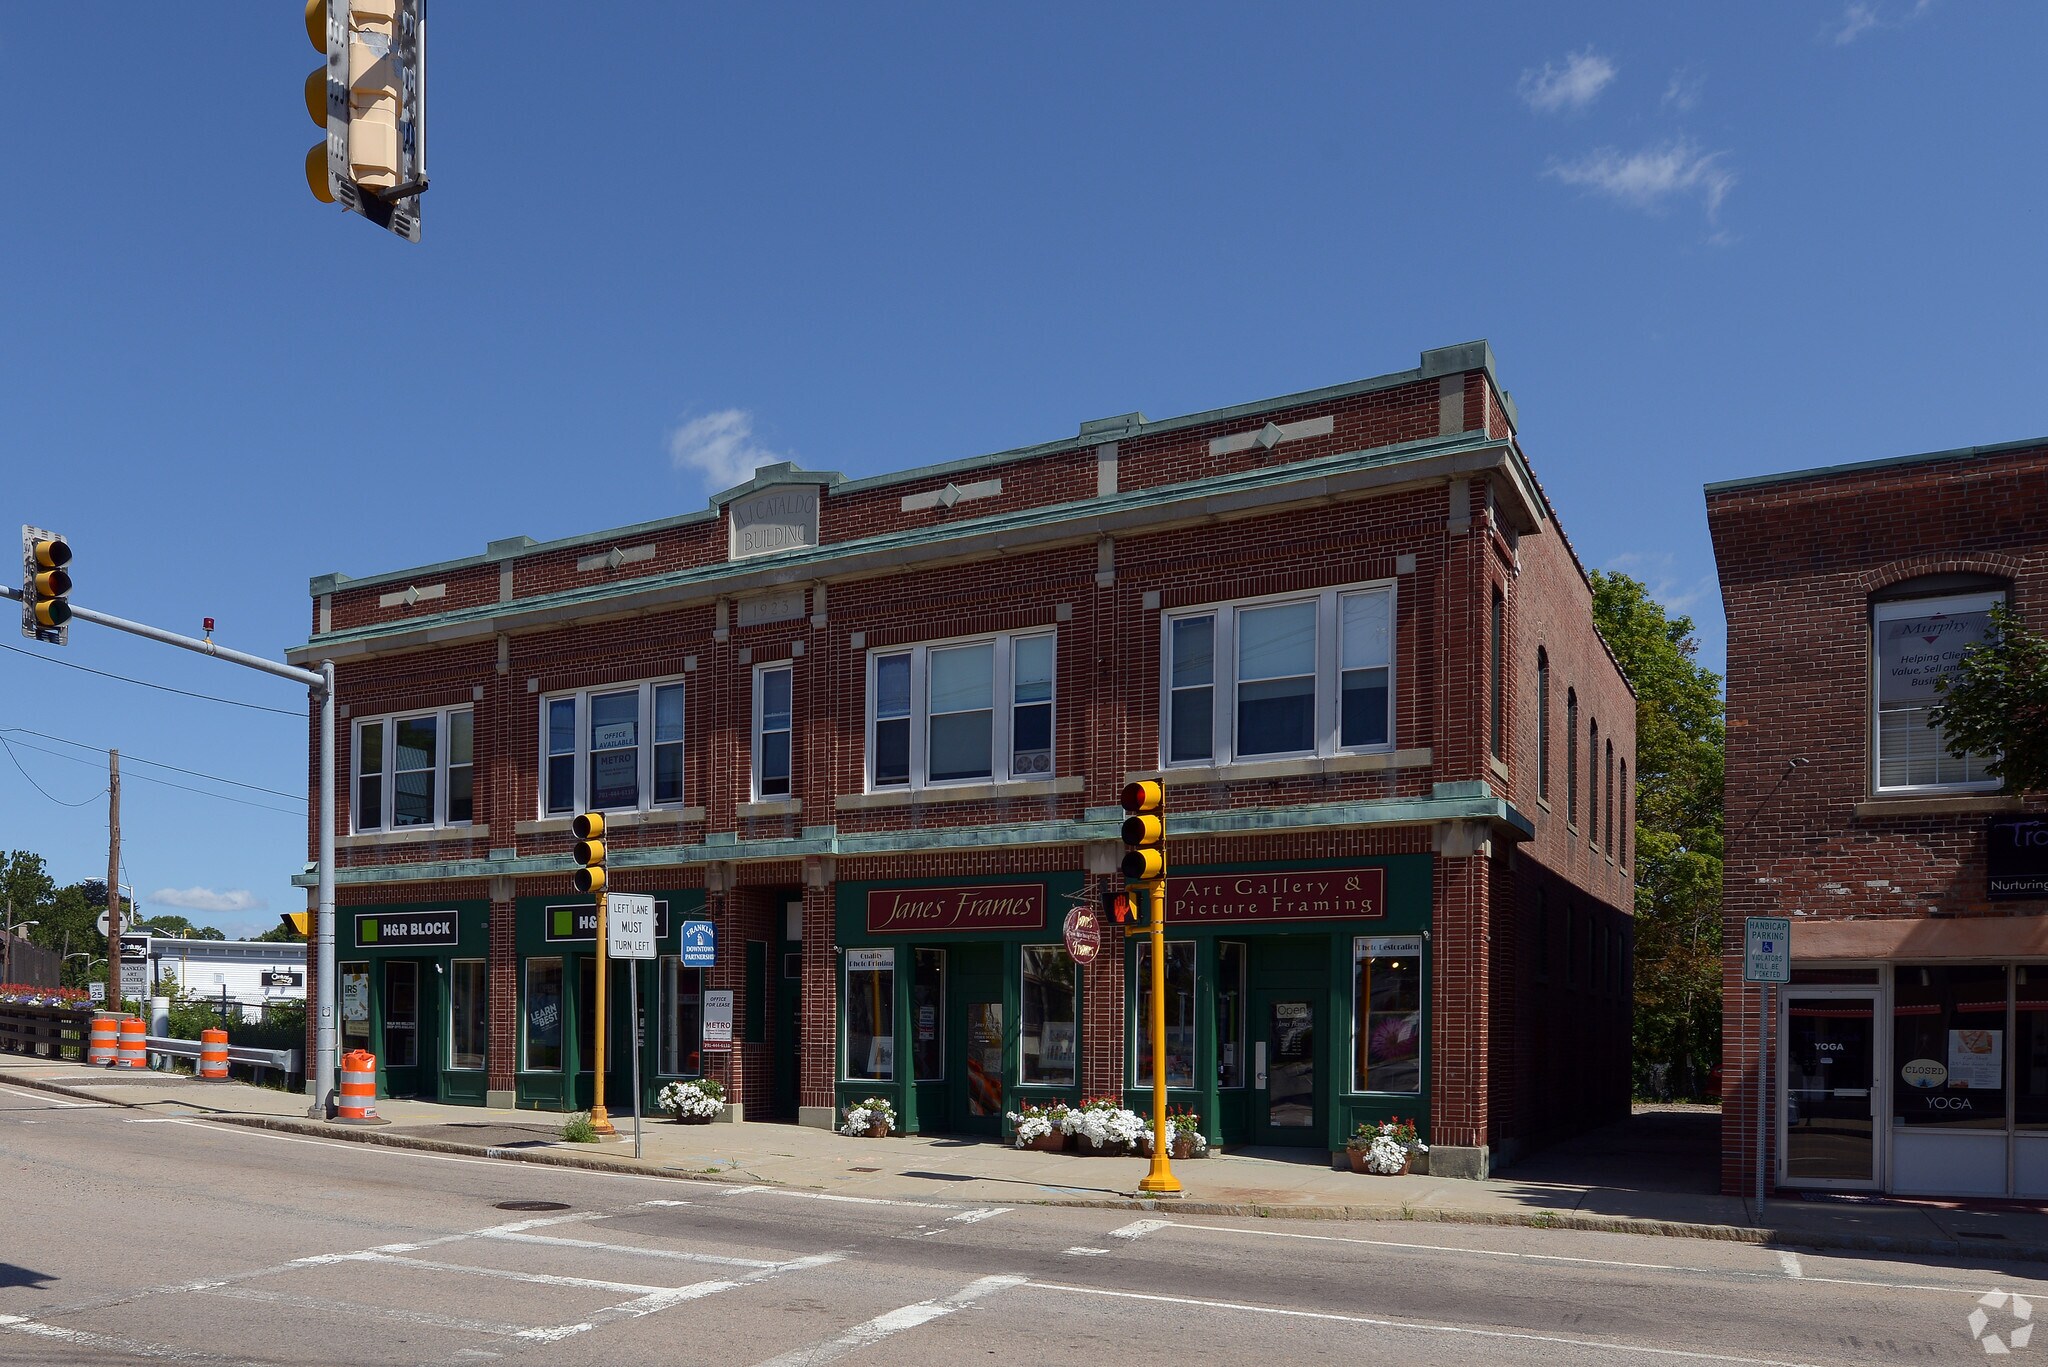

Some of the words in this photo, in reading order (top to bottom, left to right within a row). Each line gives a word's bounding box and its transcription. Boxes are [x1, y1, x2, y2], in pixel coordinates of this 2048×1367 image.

[757, 496, 815, 519] CATALDO
[744, 523, 807, 551] BUILDING
[753, 600, 789, 617] 1923
[1902, 621, 1969, 635] Murphy
[1901, 654, 1940, 665] Helping
[1892, 666, 1922, 676] Value,
[1924, 665, 1941, 673] Sell
[604, 731, 626, 739] OFFICE
[600, 739, 633, 748] AVAILABLE
[601, 754, 631, 765] METRO
[1182, 881, 1222, 897] Art
[1235, 879, 1329, 896] Gallery
[1344, 875, 1363, 891] &
[613, 903, 629, 913] LEFT
[632, 905, 649, 915] LANE
[945, 892, 1035, 928] Frames
[1174, 900, 1258, 915] Picture
[1272, 896, 1373, 914] Framing
[383, 923, 408, 936] H&R
[410, 922, 450, 936] BLOCK
[621, 921, 642, 933] MUST
[686, 924, 714, 938] FRANKLIN
[1749, 921, 1787, 931] HANDICAP
[1752, 931, 1784, 941] PARKING
[615, 940, 632, 951] TURN
[635, 942, 650, 951] LEFT
[1752, 954, 1783, 962] VIOLATORS
[1755, 962, 1768, 970] WILL
[345, 984, 358, 994] IRS
[91, 991, 103, 999] 25
[530, 1003, 558, 1021] LEARN
[1278, 1005, 1305, 1017] Open
[539, 1011, 558, 1027] BEST
[706, 1021, 731, 1029] METRO
[1814, 1043, 1845, 1051] YOGA
[1905, 1066, 1945, 1075] CLOSED
[1925, 1097, 1972, 1110] YOGA
